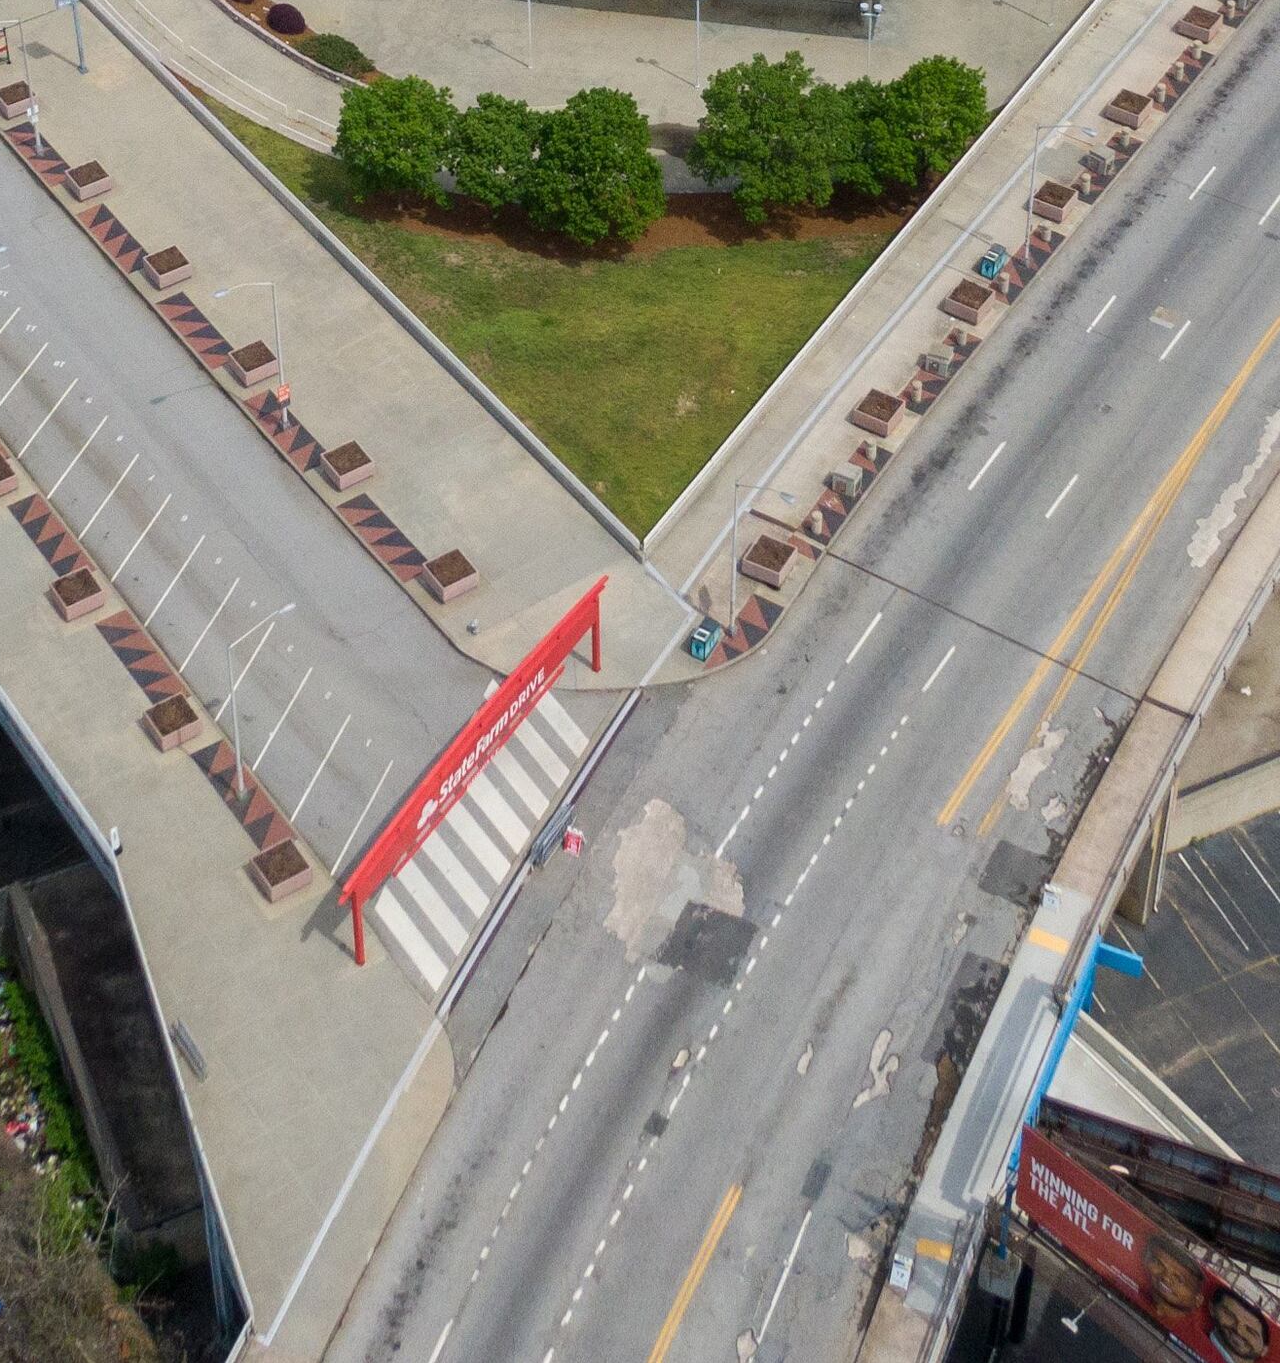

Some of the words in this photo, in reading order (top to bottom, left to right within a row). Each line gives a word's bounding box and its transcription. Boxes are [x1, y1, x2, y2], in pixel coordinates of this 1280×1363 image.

[509, 667, 545, 719] DRIVE
[1029, 1170, 1058, 1211] THE
[1031, 1155, 1099, 1222] WINNING
[1102, 1214, 1134, 1252] FOR
